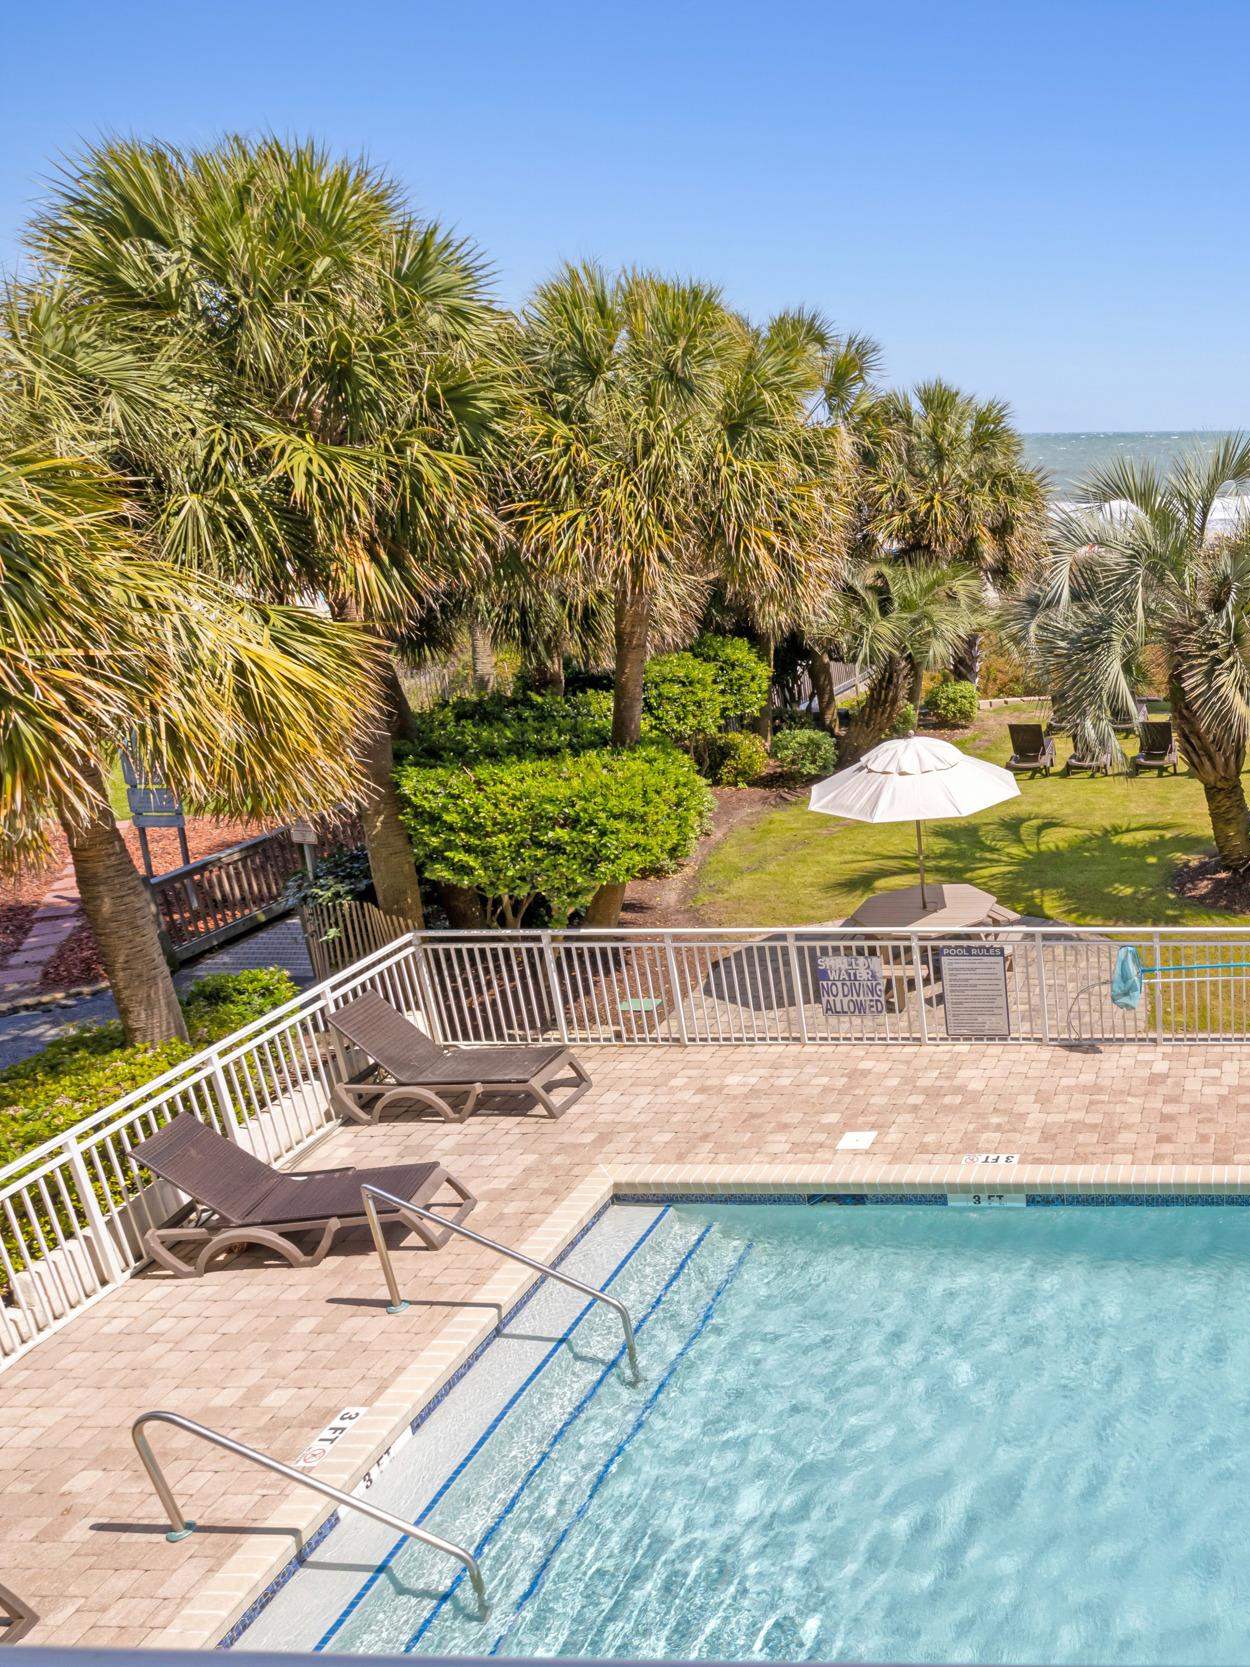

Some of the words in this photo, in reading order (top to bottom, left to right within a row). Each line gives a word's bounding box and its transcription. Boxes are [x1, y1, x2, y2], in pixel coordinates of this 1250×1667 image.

[943, 948, 970, 956] POOL
[971, 948, 1001, 956] RULES
[827, 969, 873, 981] WATER
[820, 982, 839, 998] NO
[841, 982, 883, 998] DIVING
[825, 998, 884, 1014] ALLOWED
[980, 1155, 1000, 1163] FT
[1004, 1155, 1015, 1163] 3
[972, 1194, 981, 1205] 3
[339, 1411, 360, 1421] 3
[318, 1426, 346, 1445] FT
